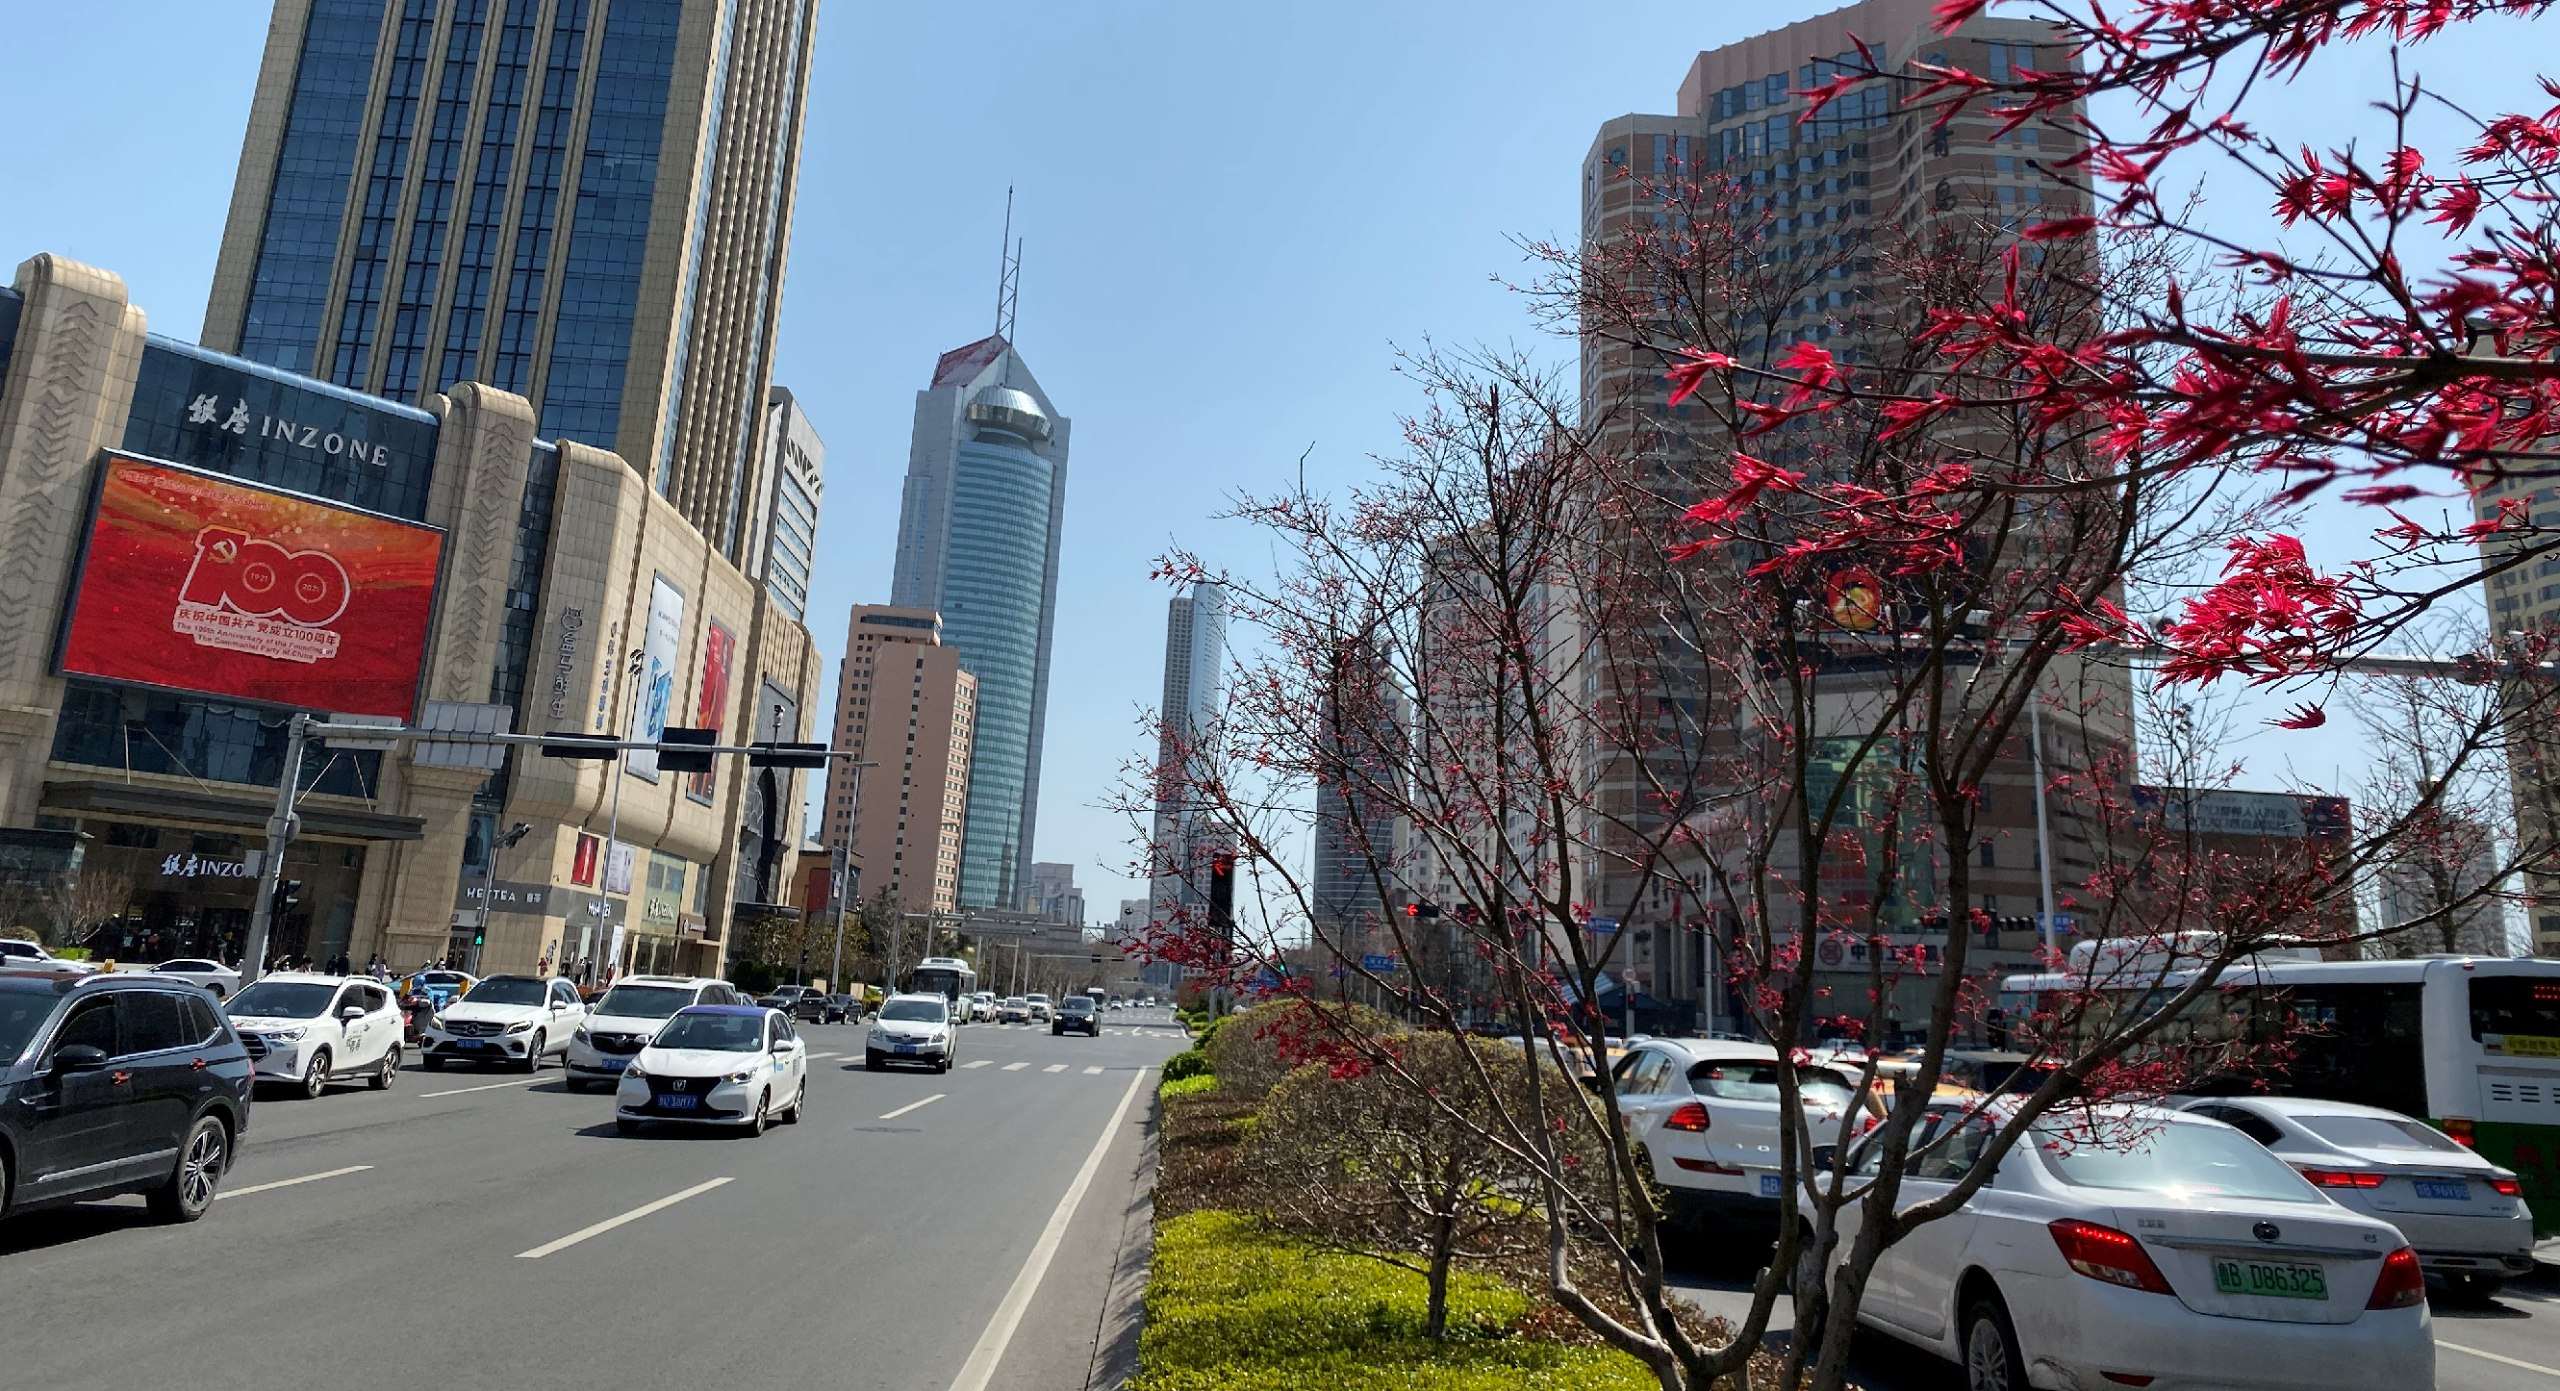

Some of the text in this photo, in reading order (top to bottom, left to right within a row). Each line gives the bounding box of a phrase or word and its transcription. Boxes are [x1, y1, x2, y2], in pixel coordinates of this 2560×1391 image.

[260, 415, 389, 467] INZONE
[178, 608, 337, 646] 庆祝中国共产党成立100周年
[216, 629, 264, 645] Anniversary
[200, 860, 258, 879] INZO
[466, 887, 515, 902] HETEA
